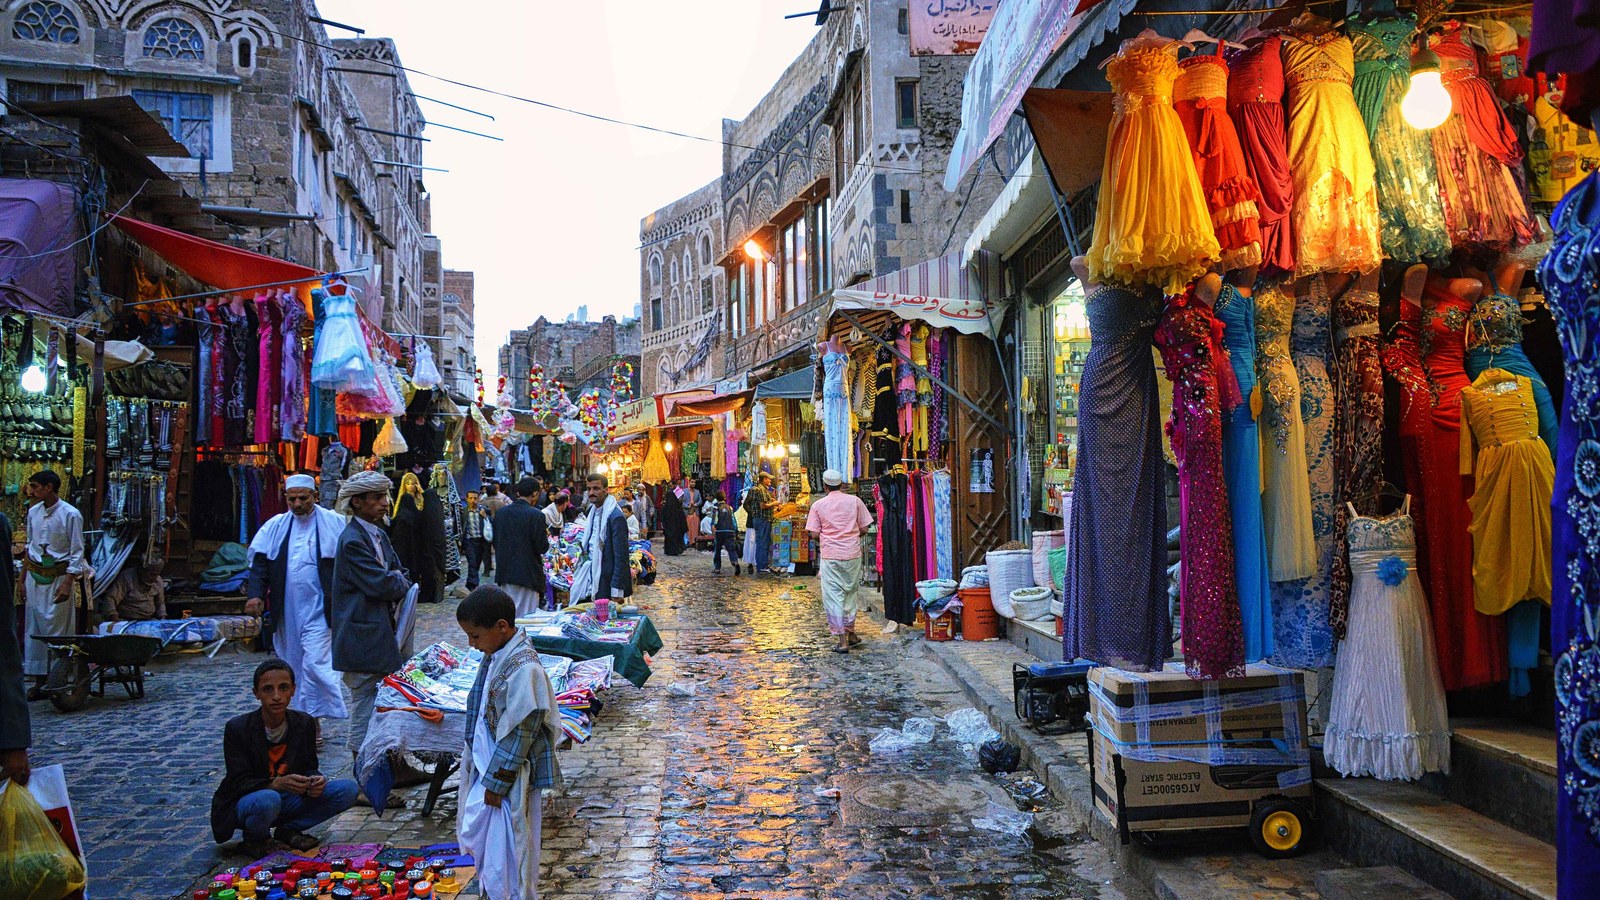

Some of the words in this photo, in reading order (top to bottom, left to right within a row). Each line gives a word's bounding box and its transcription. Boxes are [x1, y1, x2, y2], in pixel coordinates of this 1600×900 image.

[1169, 717, 1197, 726] GERMAN
[1141, 773, 1164, 783] START
[1167, 771, 1200, 782] ELECTRIC
[1142, 783, 1200, 796] ATG6500CET
